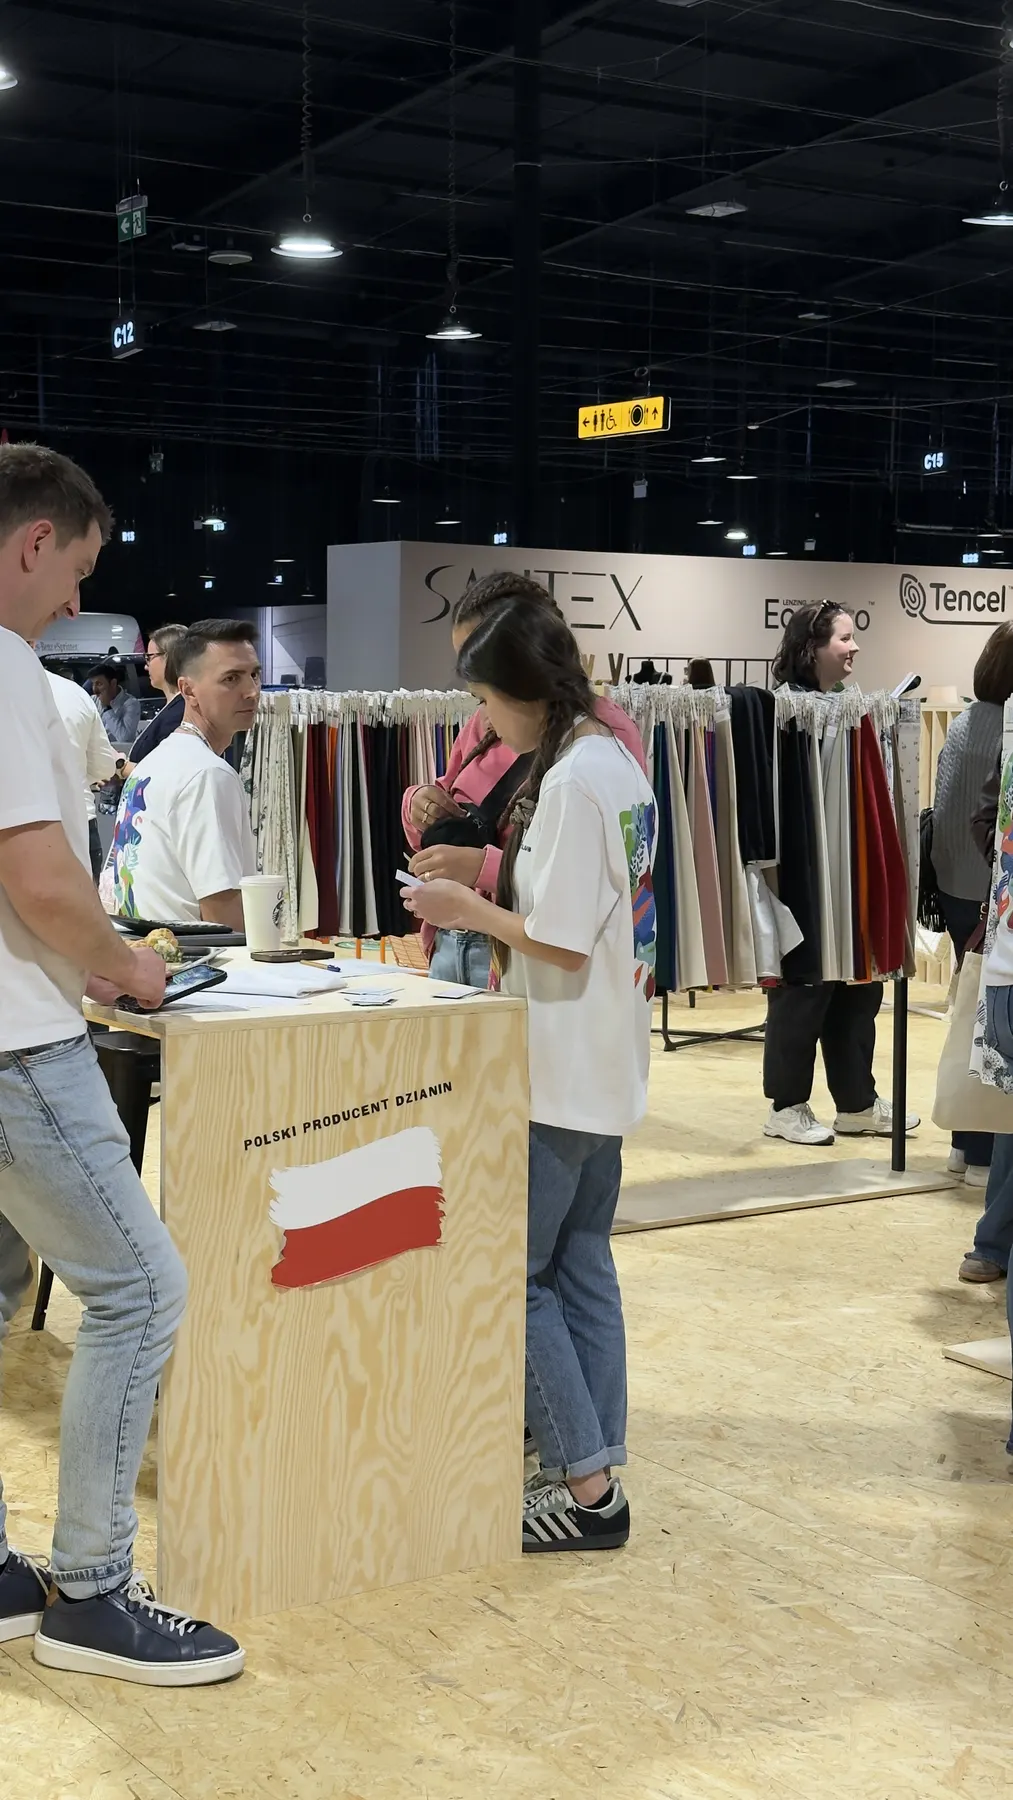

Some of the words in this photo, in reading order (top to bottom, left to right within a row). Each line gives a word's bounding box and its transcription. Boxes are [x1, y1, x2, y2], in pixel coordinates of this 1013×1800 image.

[113, 321, 135, 349] C12
[924, 452, 944, 470] C15
[929, 582, 1006, 613] Tencel
[243, 1125, 297, 1151] POLSKI
[303, 1098, 389, 1134] PRODUCENT
[395, 1081, 453, 1107] DZIANIN
